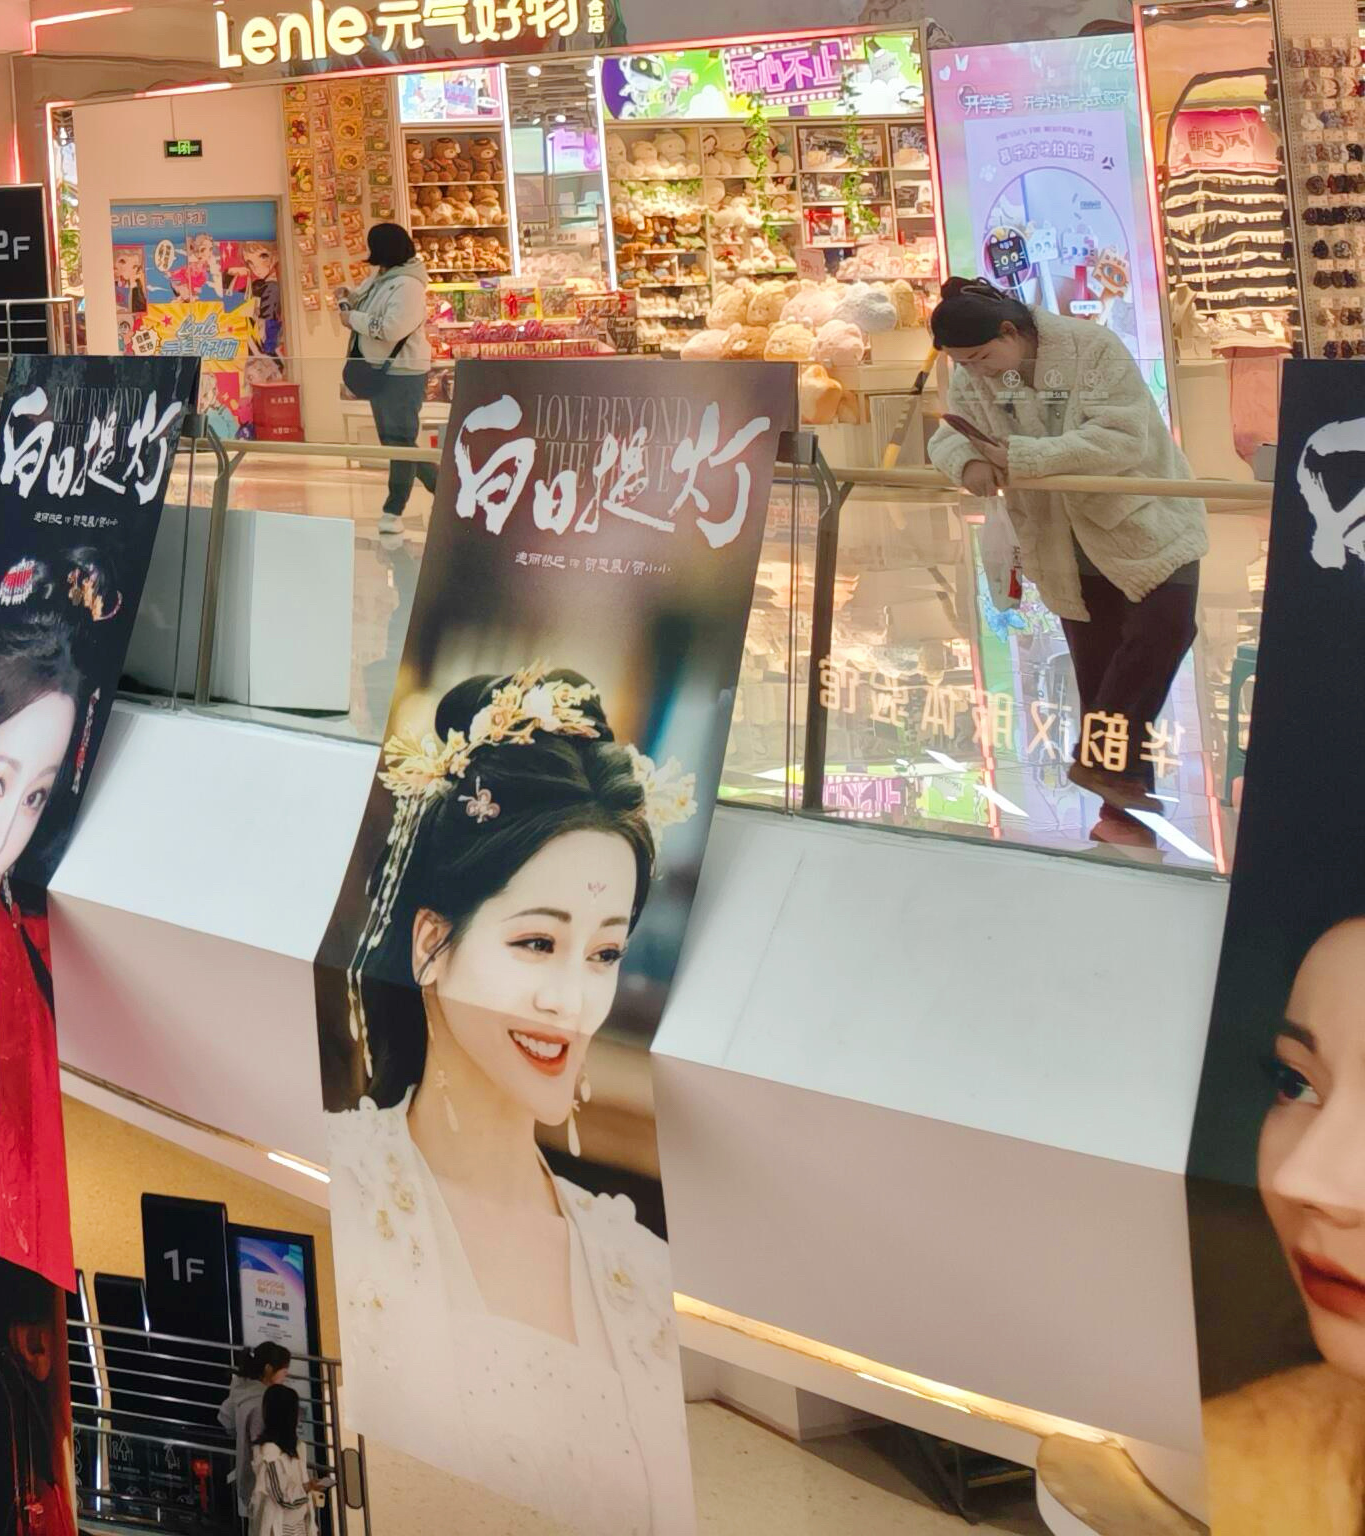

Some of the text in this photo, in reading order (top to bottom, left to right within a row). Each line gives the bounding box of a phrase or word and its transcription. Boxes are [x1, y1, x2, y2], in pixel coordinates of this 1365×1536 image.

[732, 44, 843, 94] 玩心不止
[535, 393, 692, 444] LOVE BEYOND
[0, 386, 183, 505] 白日提灯
[455, 394, 770, 549] 白日提灯
[163, 1248, 205, 1283] 1F
